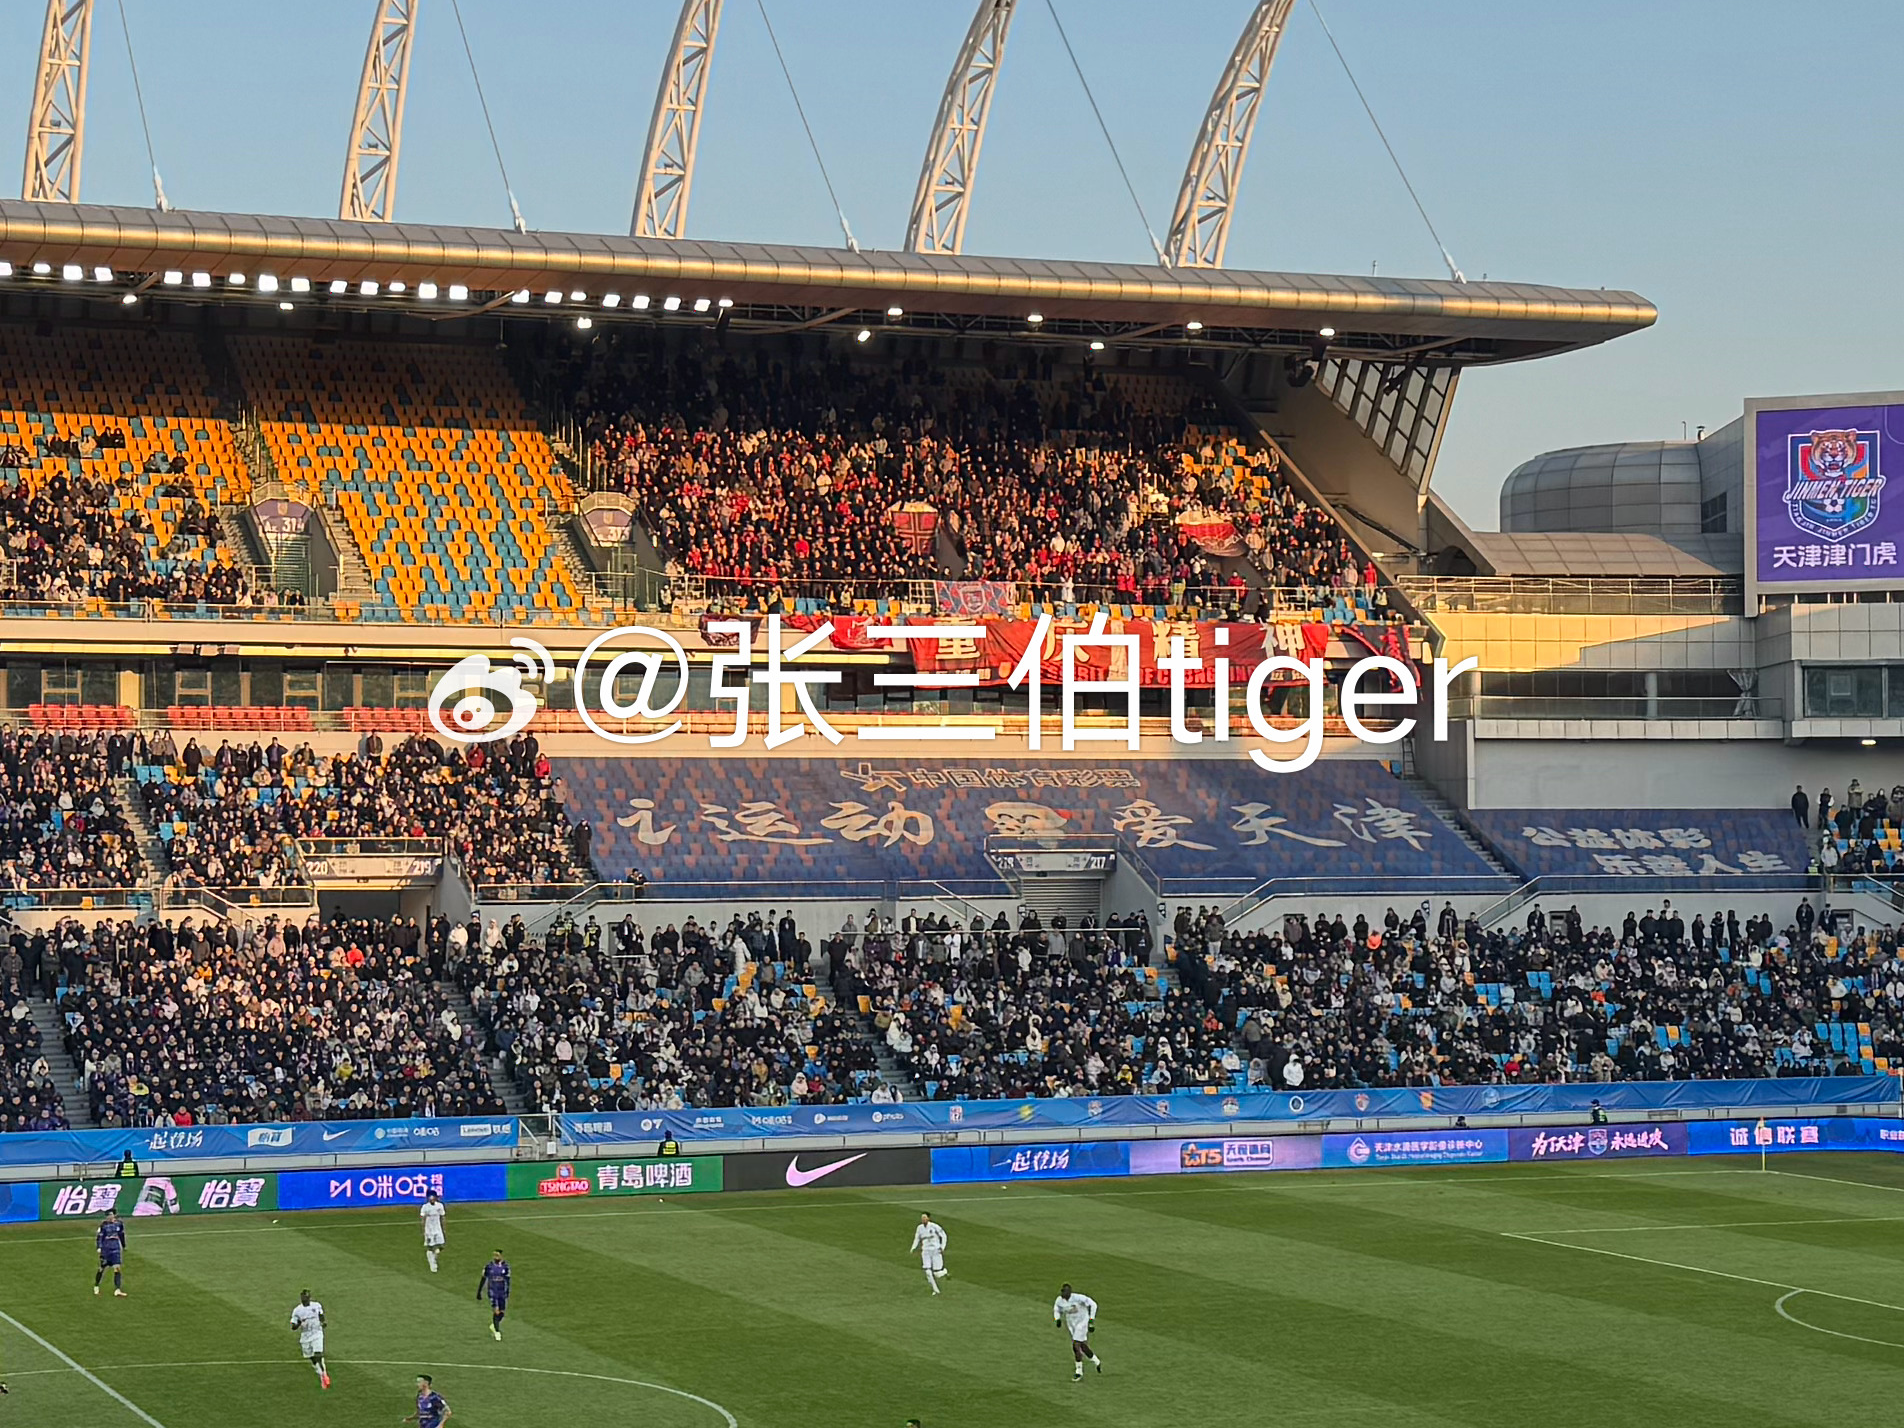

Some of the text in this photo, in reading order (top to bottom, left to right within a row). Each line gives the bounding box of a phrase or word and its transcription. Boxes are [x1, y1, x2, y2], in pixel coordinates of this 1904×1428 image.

[1785, 477, 1883, 501] JINMEN TIGER
[1773, 541, 1897, 568] 天津津门虎
[907, 766, 1142, 789] 中国体育彩票
[1111, 797, 1434, 851] 爱天津
[1521, 826, 1713, 849] 公益体彩
[306, 861, 328, 875] 220
[412, 860, 431, 874] 219
[1090, 856, 1106, 869] 217
[1592, 850, 1793, 875] 乐善人生
[1532, 1128, 1669, 1156] 为了天津 永远进攻
[1730, 1125, 1819, 1146] 诚信联赛
[992, 1148, 1070, 1173] 一起登场
